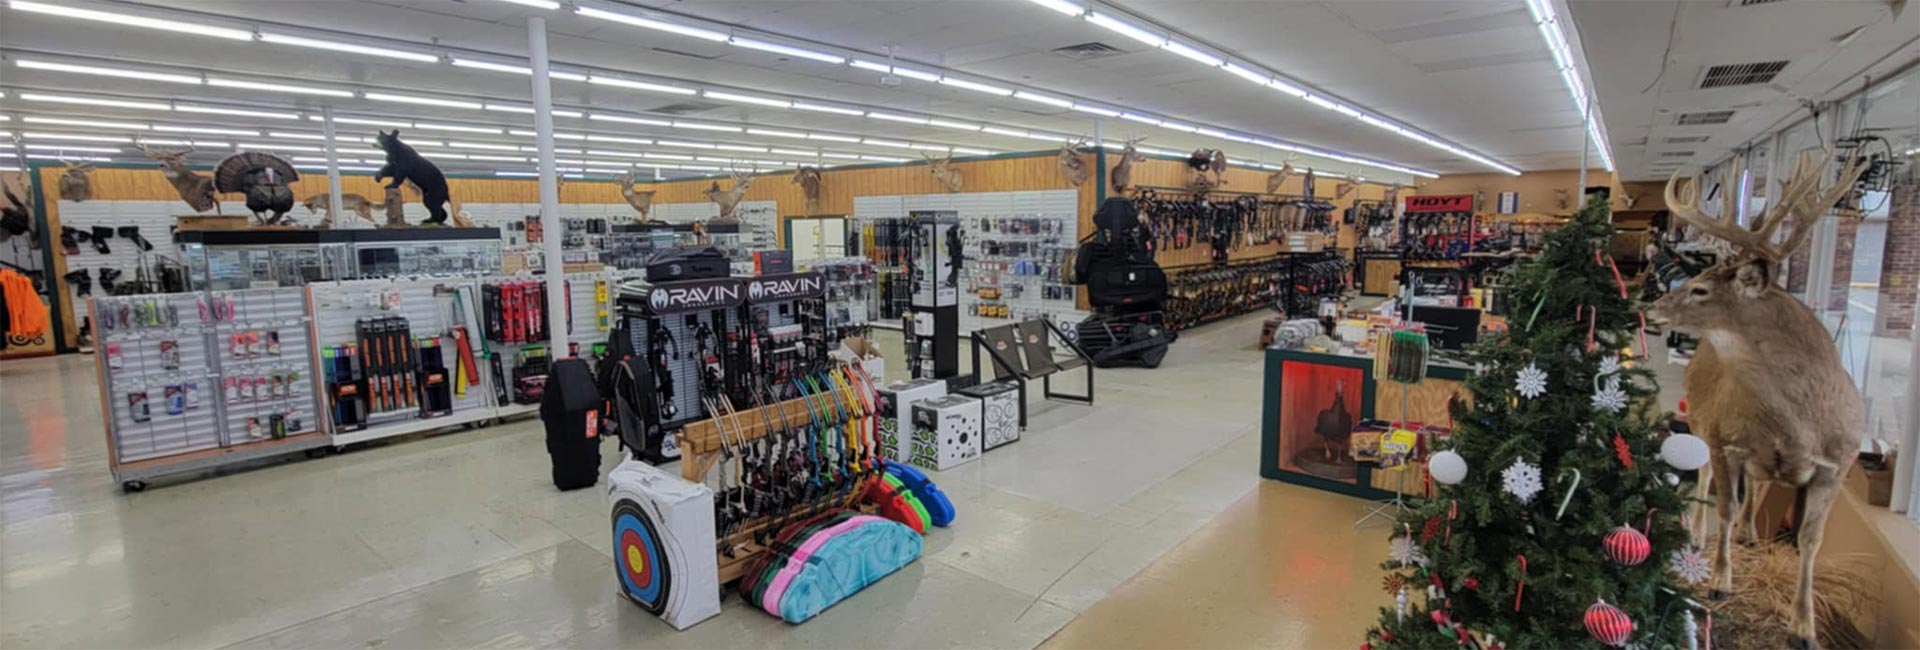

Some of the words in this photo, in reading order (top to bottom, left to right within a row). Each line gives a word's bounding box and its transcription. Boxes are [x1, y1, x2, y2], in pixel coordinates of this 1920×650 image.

[1413, 197, 1462, 205] HOYT
[669, 285, 738, 305] RAVIN
[764, 277, 820, 296] RAVIN
